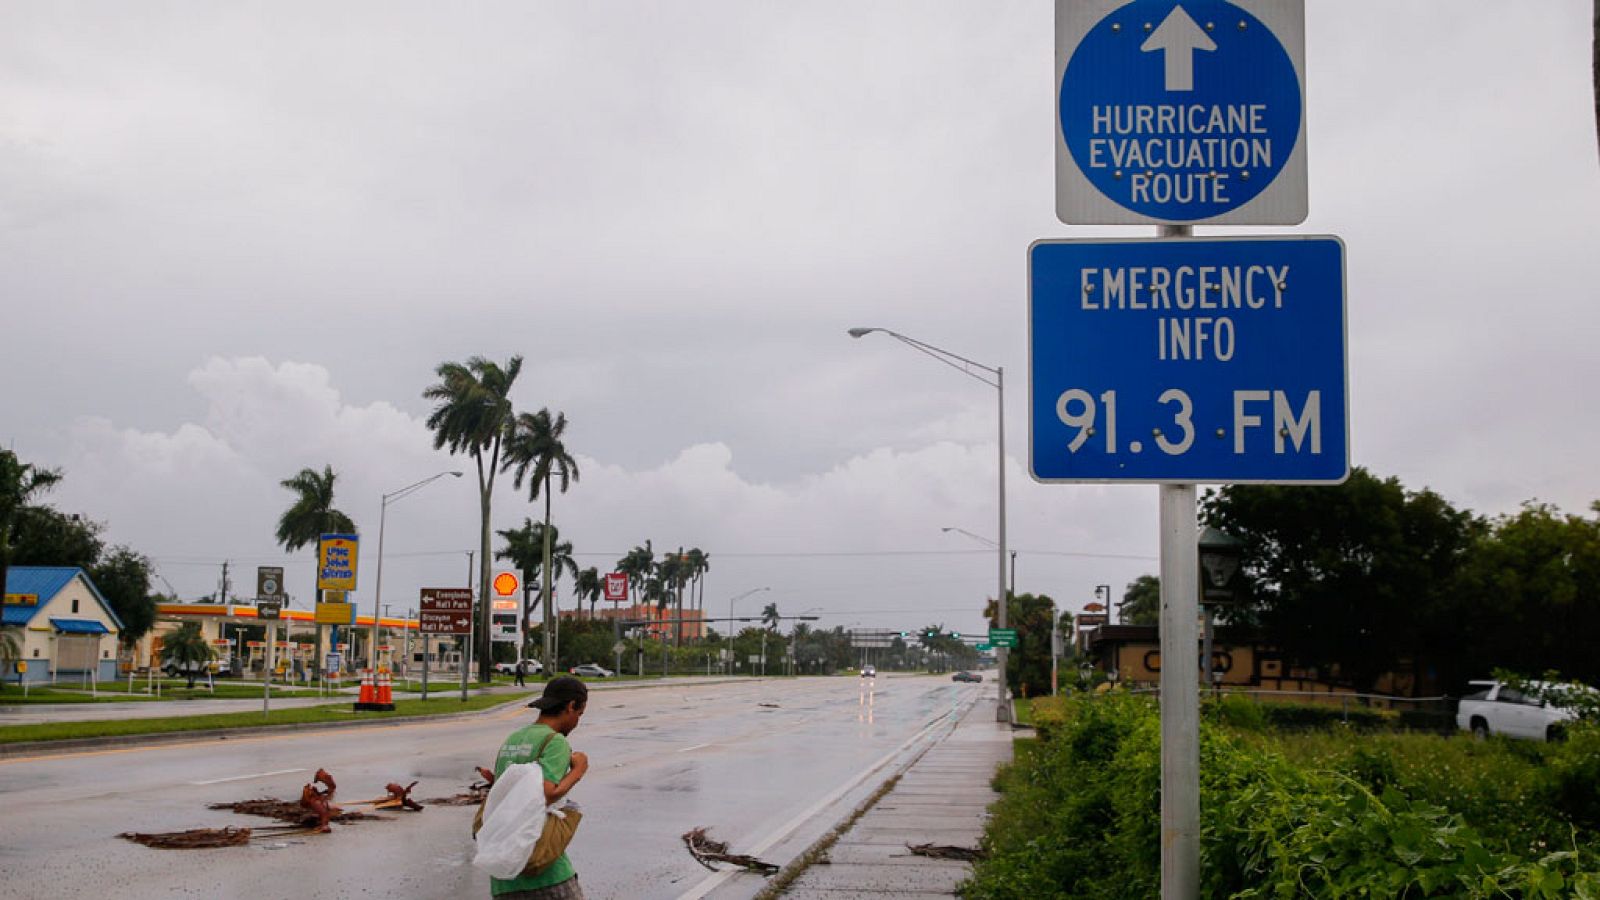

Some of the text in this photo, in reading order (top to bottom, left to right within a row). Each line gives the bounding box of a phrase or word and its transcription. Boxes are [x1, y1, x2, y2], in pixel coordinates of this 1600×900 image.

[1092, 104, 1267, 135] HURRICANE
[1089, 138, 1272, 168] EVACUATION
[1131, 173, 1230, 204] ROUTE
[1080, 265, 1290, 311] EMERGENCY
[1158, 317, 1236, 362] INFO
[1055, 388, 1322, 456] 91.3 FM
[452, 600, 468, 609] Park
[438, 622, 454, 631] Park
